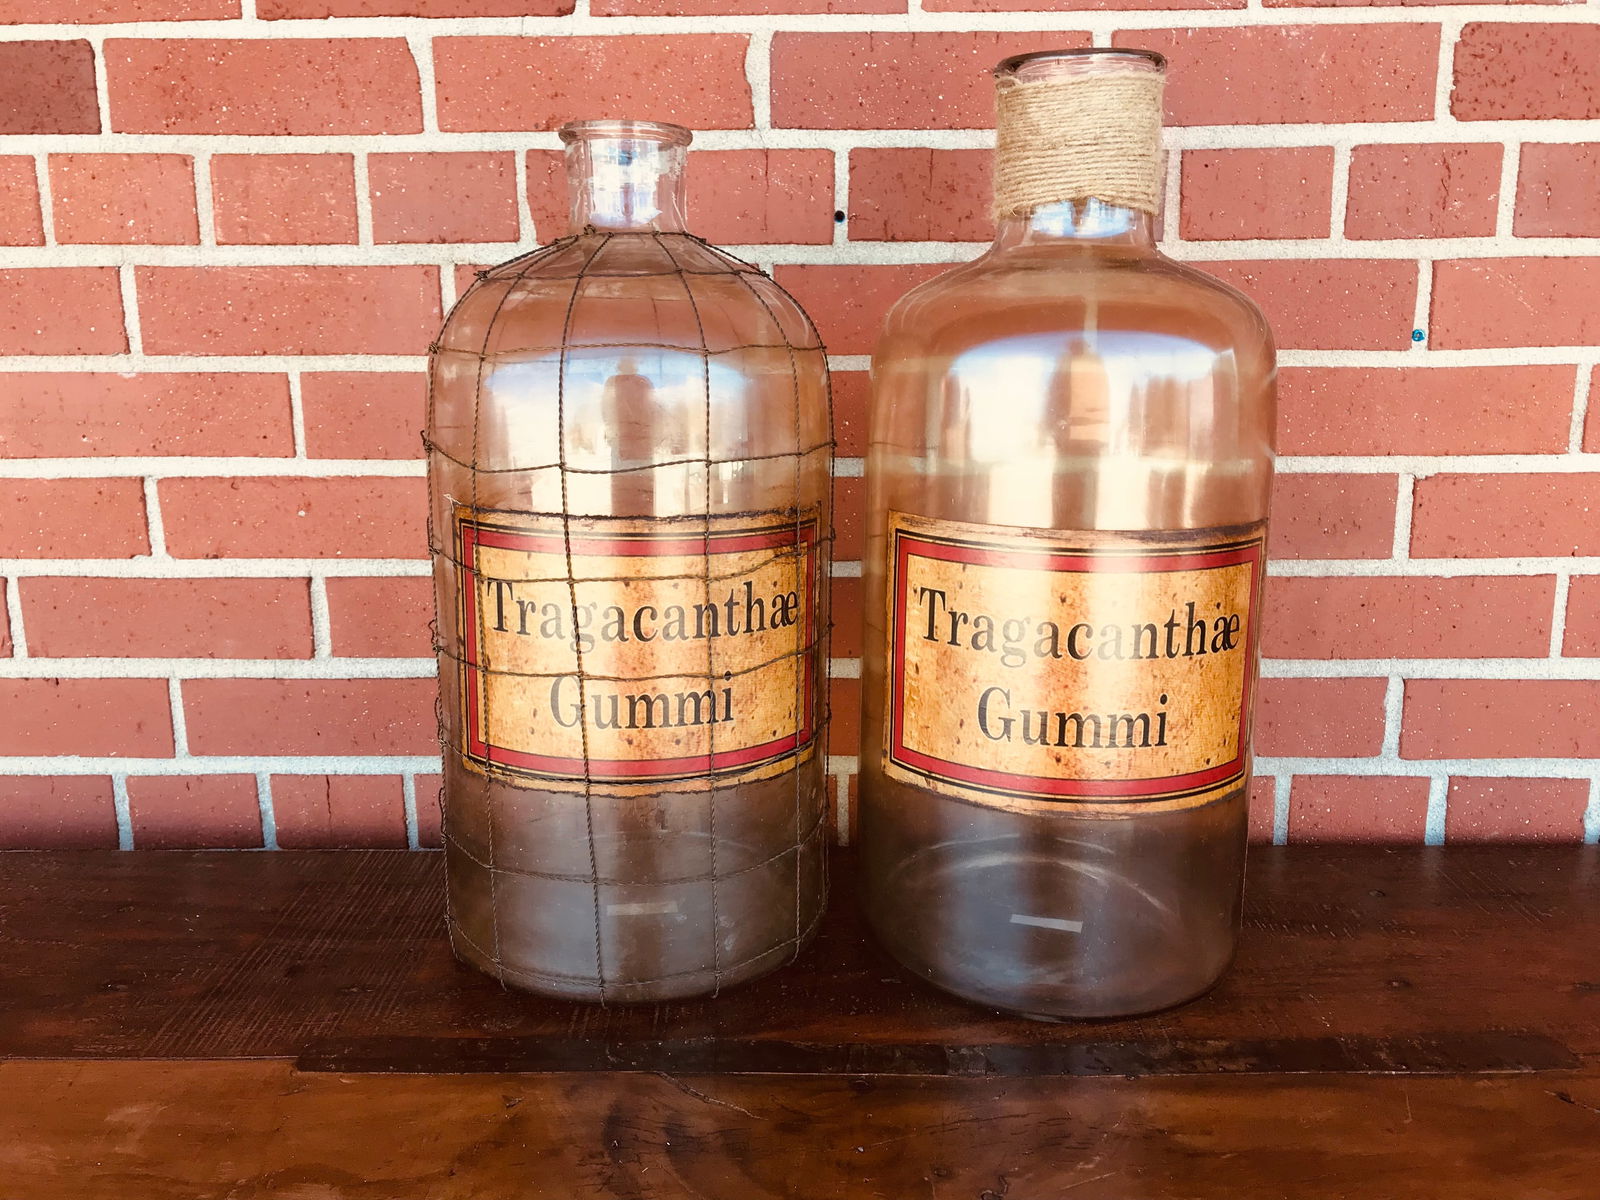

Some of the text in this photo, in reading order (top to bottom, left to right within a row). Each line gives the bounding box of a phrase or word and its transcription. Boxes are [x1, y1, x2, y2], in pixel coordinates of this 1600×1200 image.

[487, 577, 799, 654] Tragacanthæ
[919, 586, 1241, 668] Tragacanthæ
[550, 671, 735, 729] Gummi
[977, 686, 1168, 749] Gummi
